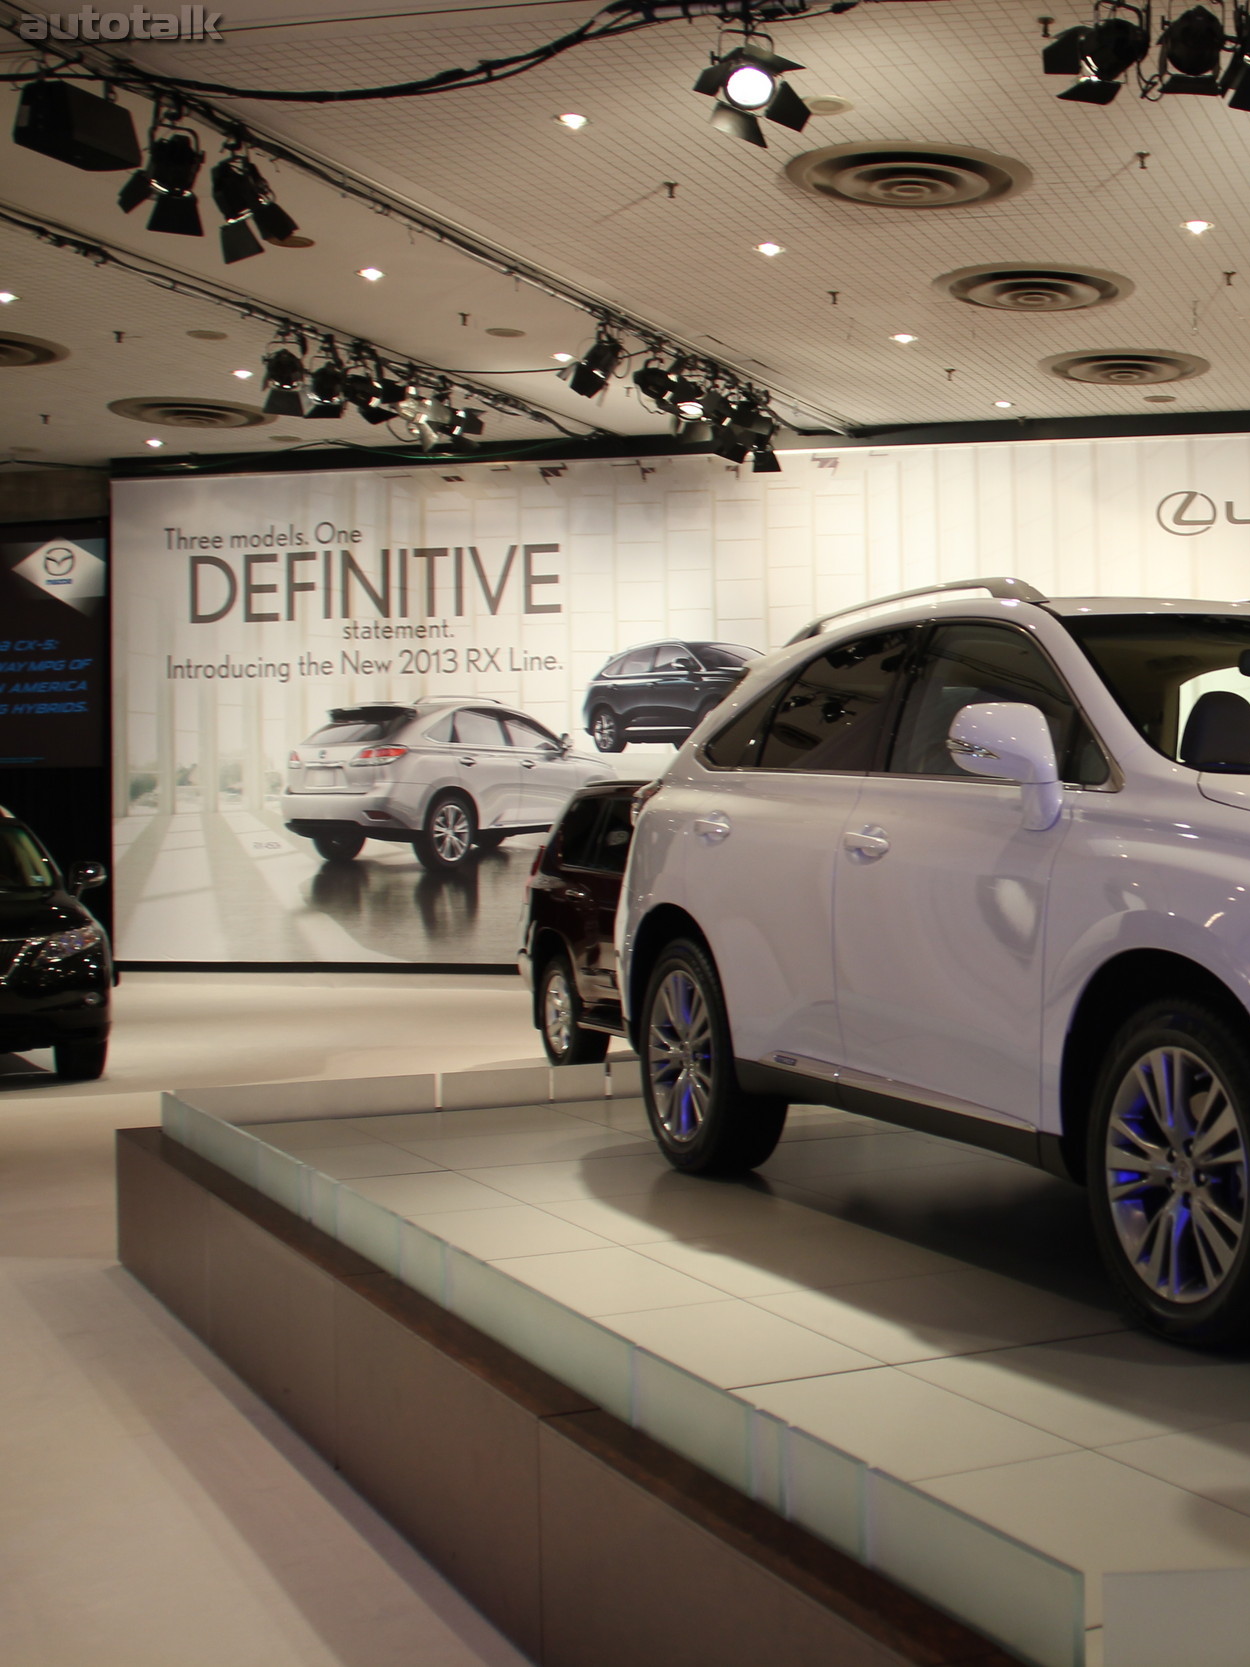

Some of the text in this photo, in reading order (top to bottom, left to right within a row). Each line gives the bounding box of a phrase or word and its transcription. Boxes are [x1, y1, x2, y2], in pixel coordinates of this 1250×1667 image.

[164, 521, 362, 550] Three models. One
[189, 542, 563, 624] DEFINITIVE
[342, 620, 454, 641] statement.
[68, 658, 93, 671] OF
[166, 645, 563, 683] Introducing the New 2013 RX Line.
[8, 680, 89, 693] AMERICA
